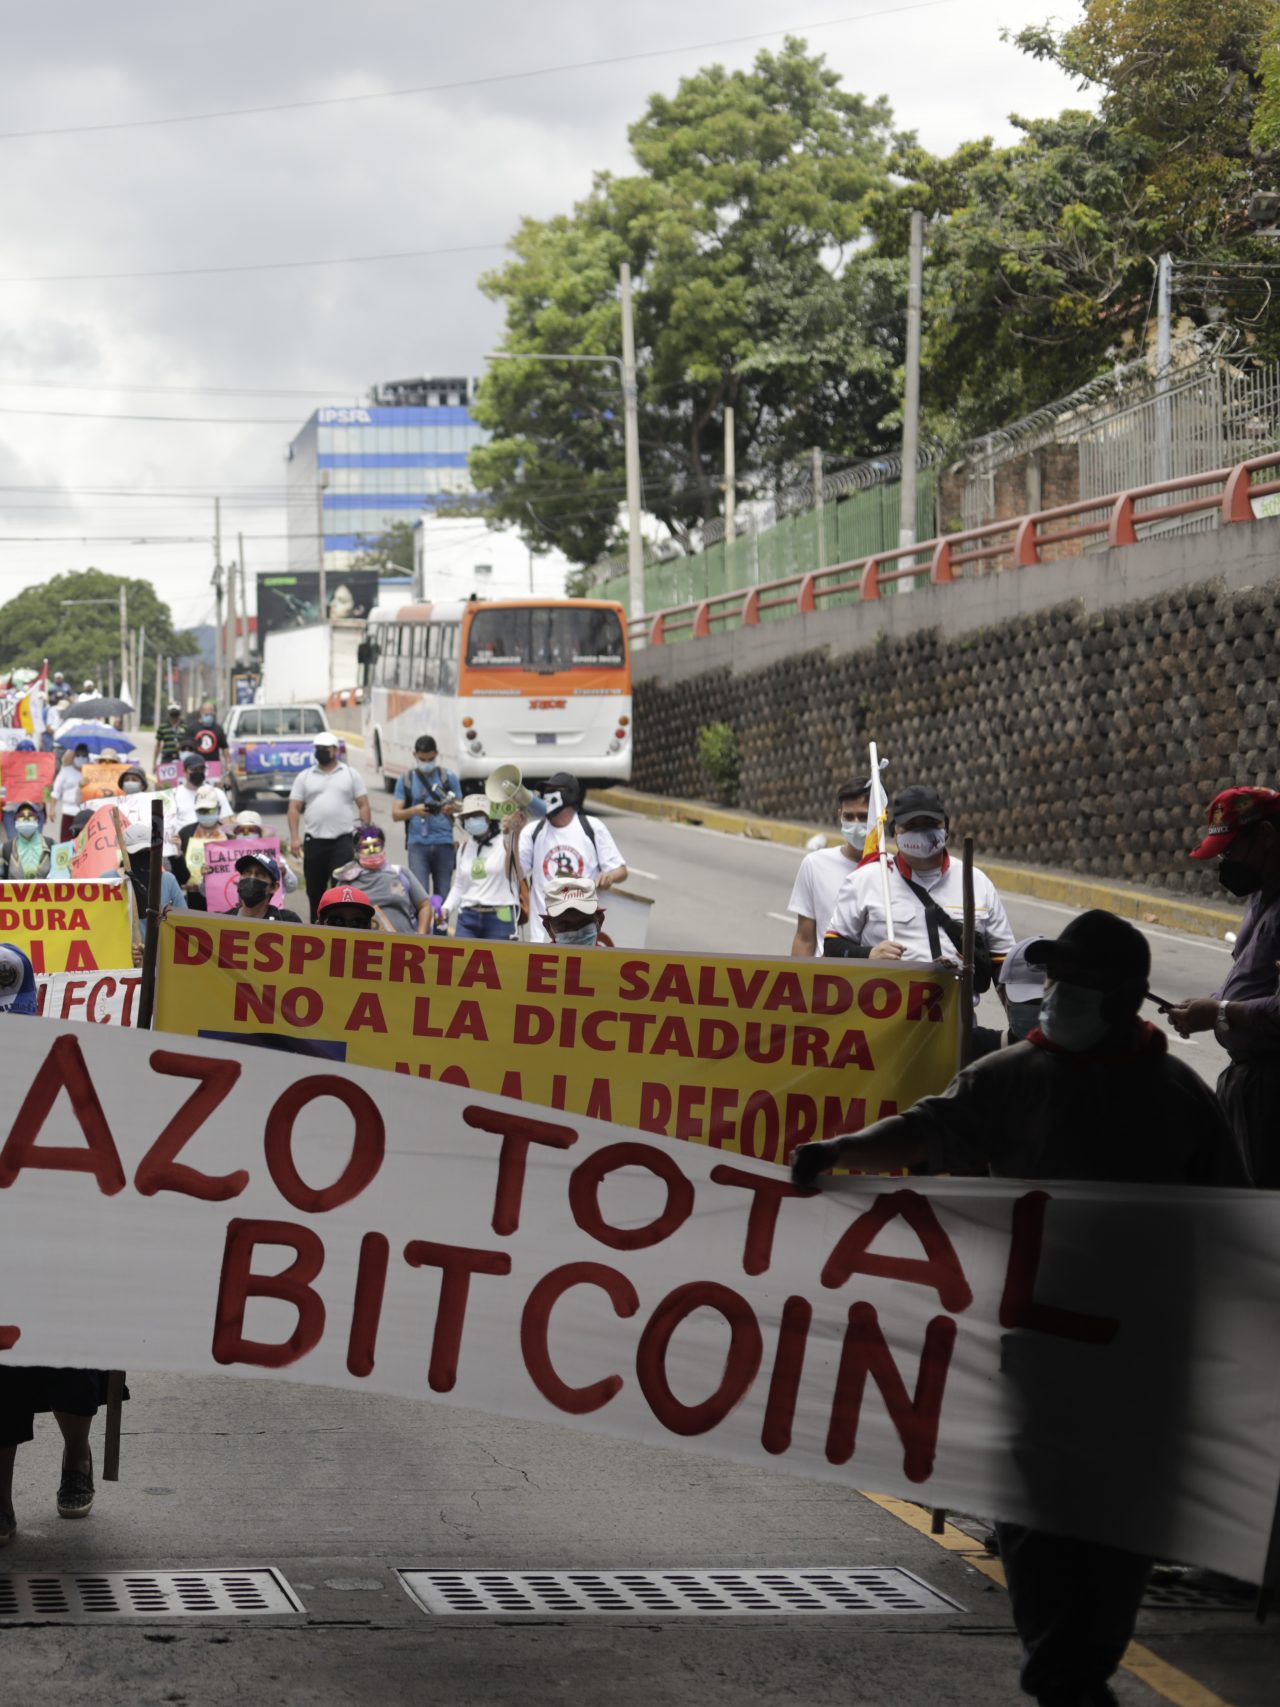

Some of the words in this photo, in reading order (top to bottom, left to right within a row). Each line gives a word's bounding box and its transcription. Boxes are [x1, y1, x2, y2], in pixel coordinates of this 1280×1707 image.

[161, 766, 176, 777] YO
[259, 752, 315, 767] LOTERI
[173, 925, 503, 990] DESPIERTA
[526, 953, 596, 998] EL
[619, 960, 945, 1023] SALVADOR
[233, 982, 325, 1029] NO
[343, 991, 389, 1034] A
[412, 996, 489, 1042] LA
[513, 1004, 876, 1072] DICTADURA
[462, 1104, 1120, 1346] TOTAL
[212, 1216, 957, 1484] BITCOIN
